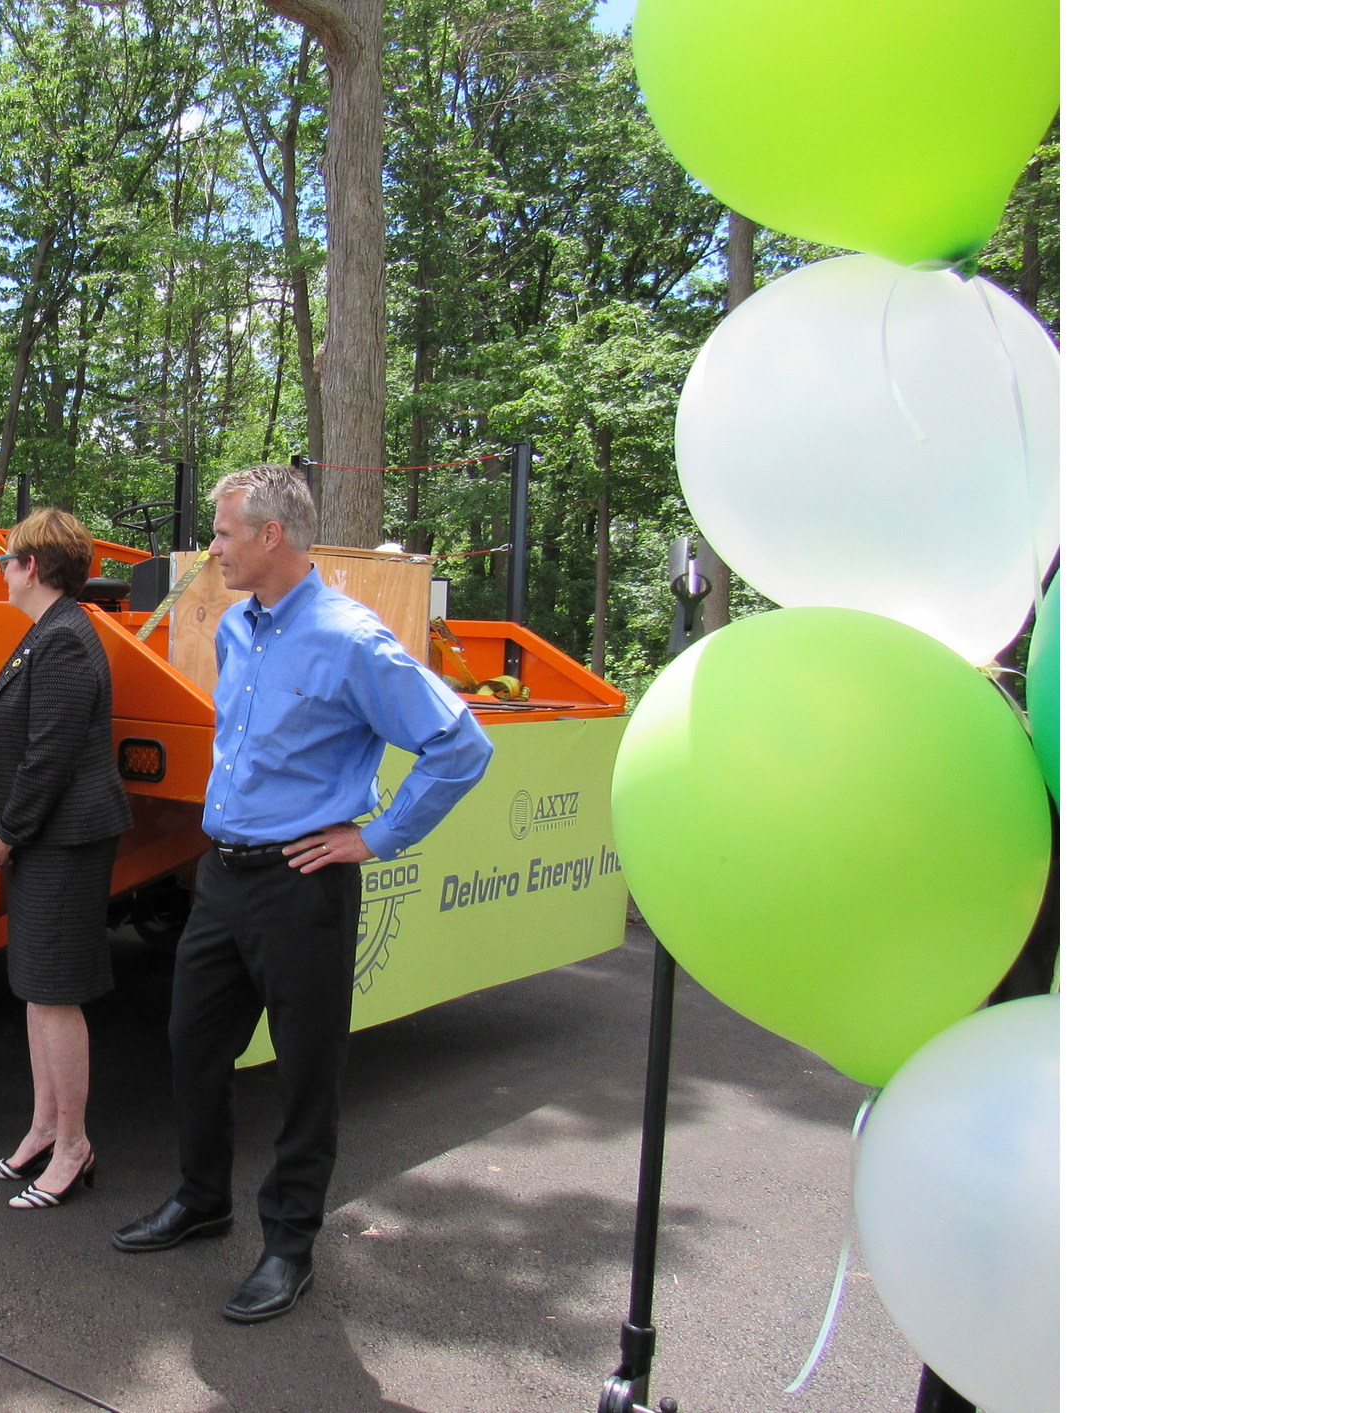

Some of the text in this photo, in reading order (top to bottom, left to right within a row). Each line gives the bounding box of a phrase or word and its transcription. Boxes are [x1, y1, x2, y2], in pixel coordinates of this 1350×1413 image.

[533, 791, 580, 820] AXYZ
[364, 863, 419, 893] 6000
[439, 866, 520, 913] Delviro
[526, 856, 595, 893] Energy
